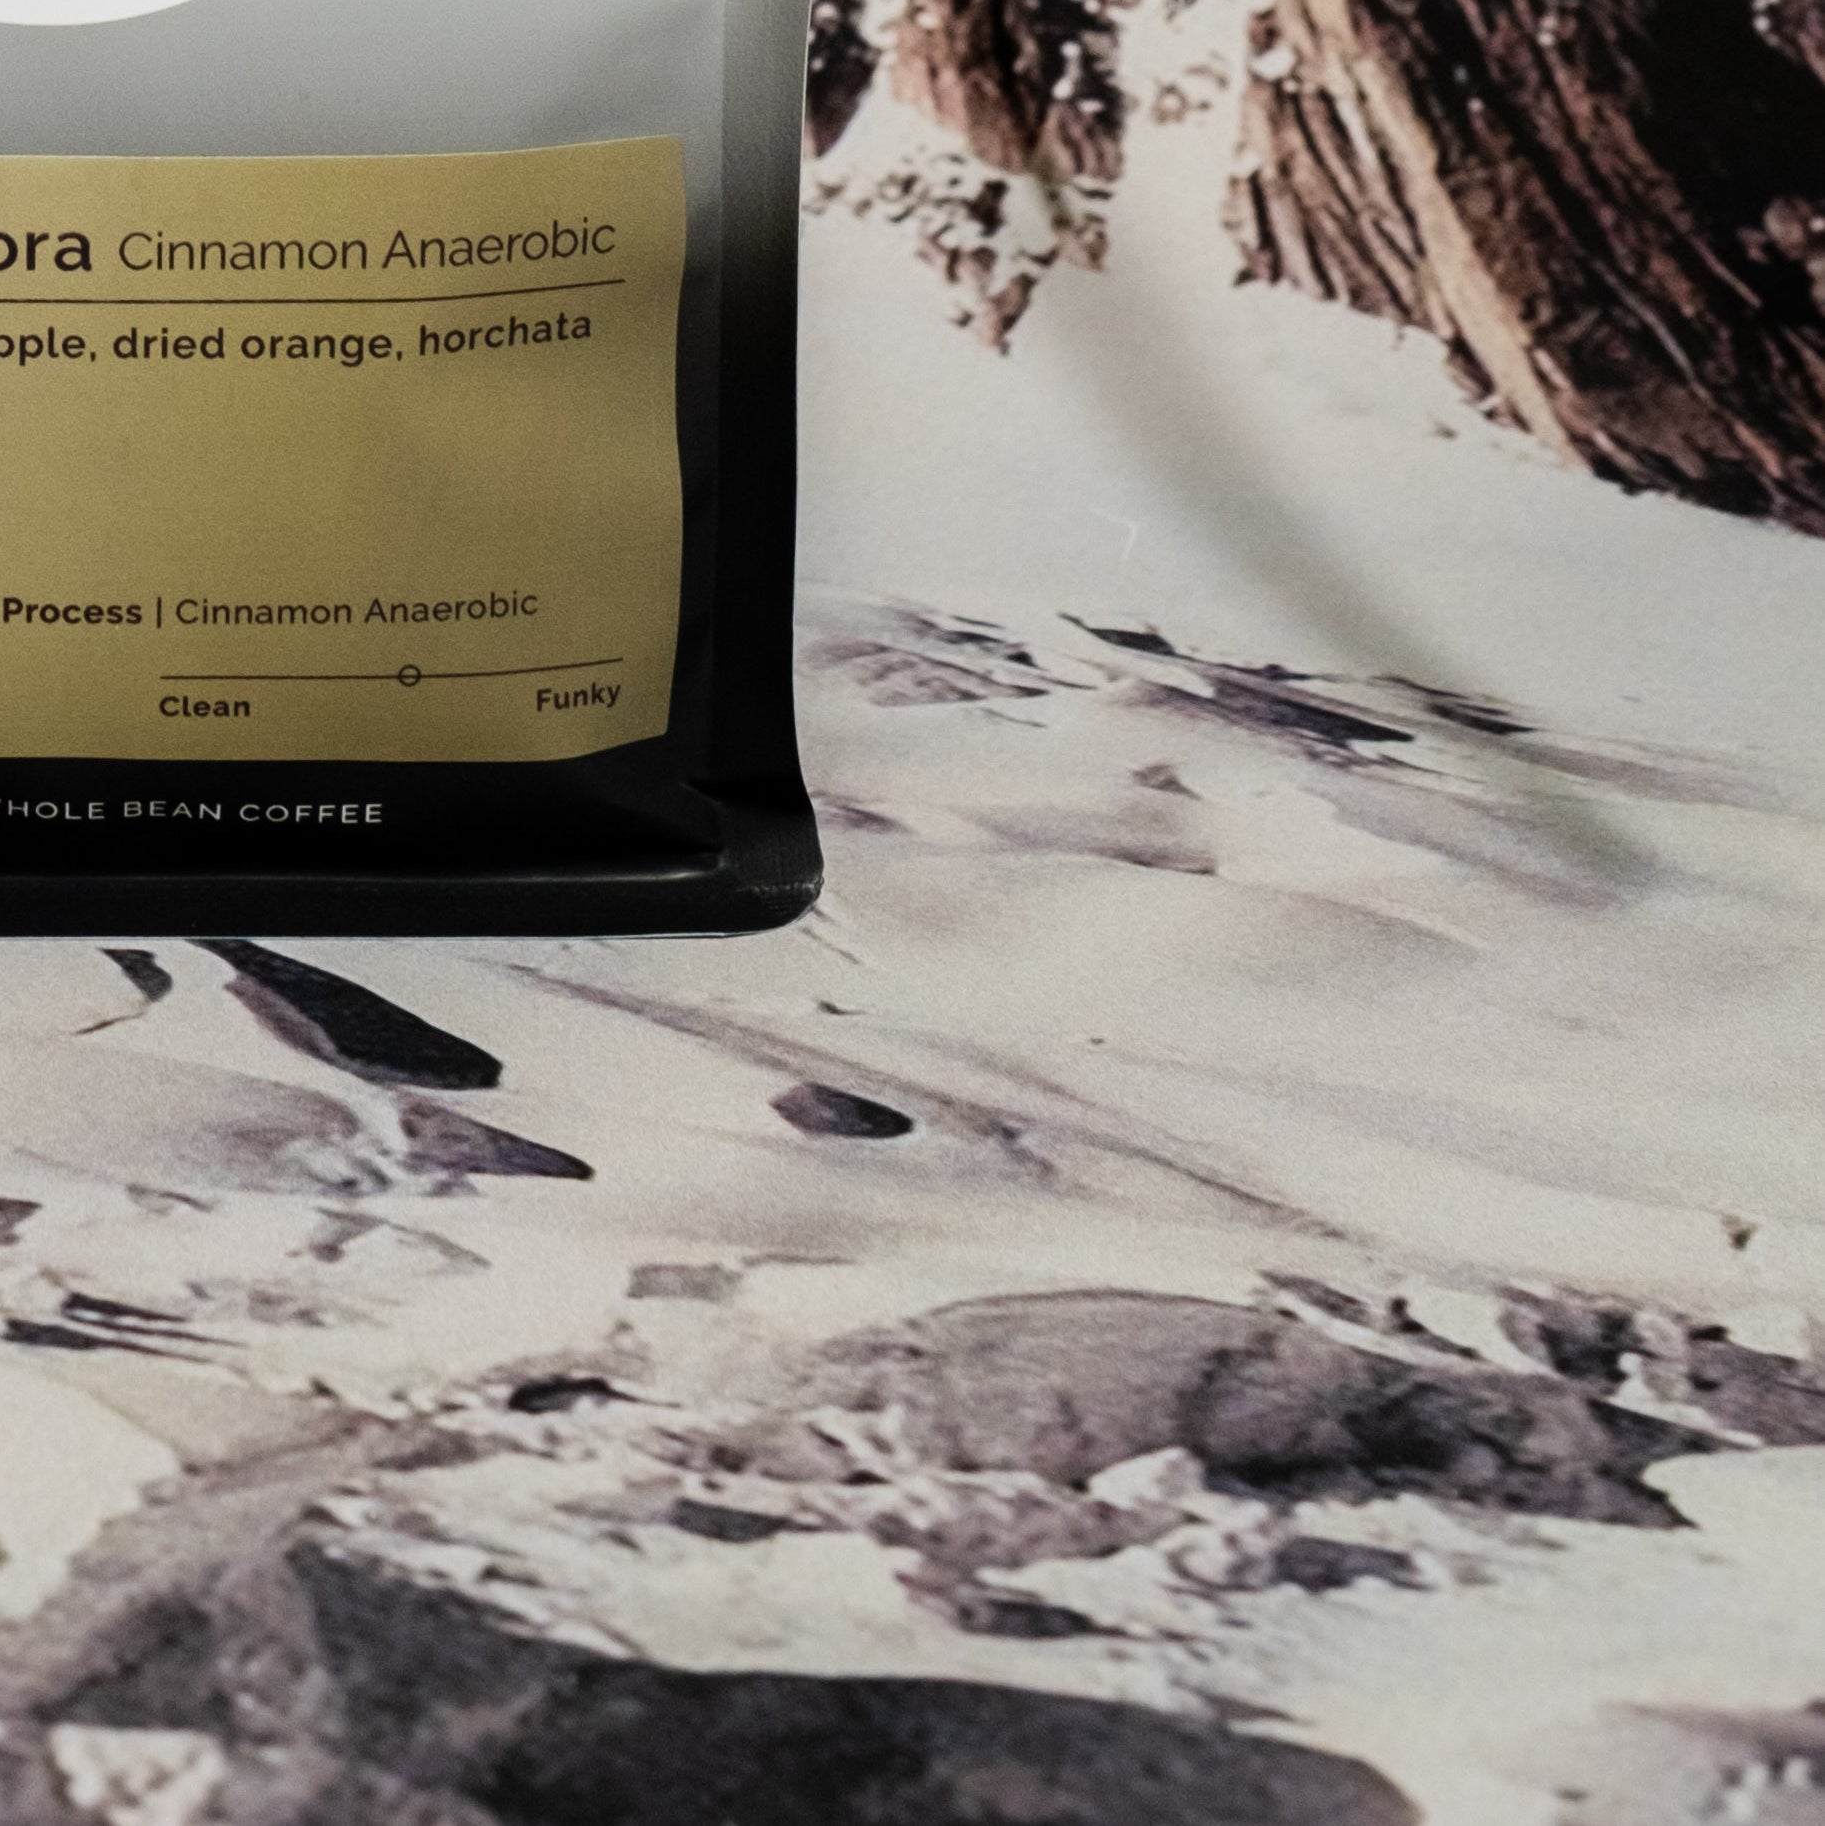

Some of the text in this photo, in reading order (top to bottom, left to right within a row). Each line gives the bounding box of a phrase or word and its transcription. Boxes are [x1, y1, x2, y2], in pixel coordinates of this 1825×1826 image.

[118, 230, 368, 272] Cinnamon
[381, 216, 616, 269] Anaerobic
[112, 326, 226, 360] dried
[240, 334, 403, 369] orange,
[419, 311, 592, 356] horchata
[2, 596, 143, 626] Process
[175, 598, 353, 625] Cinnamon
[363, 589, 538, 624] Anaerobic
[158, 695, 251, 718] Clean
[536, 681, 622, 713] Funky
[123, 800, 222, 821] BEAN
[238, 802, 382, 825] COFFEE
